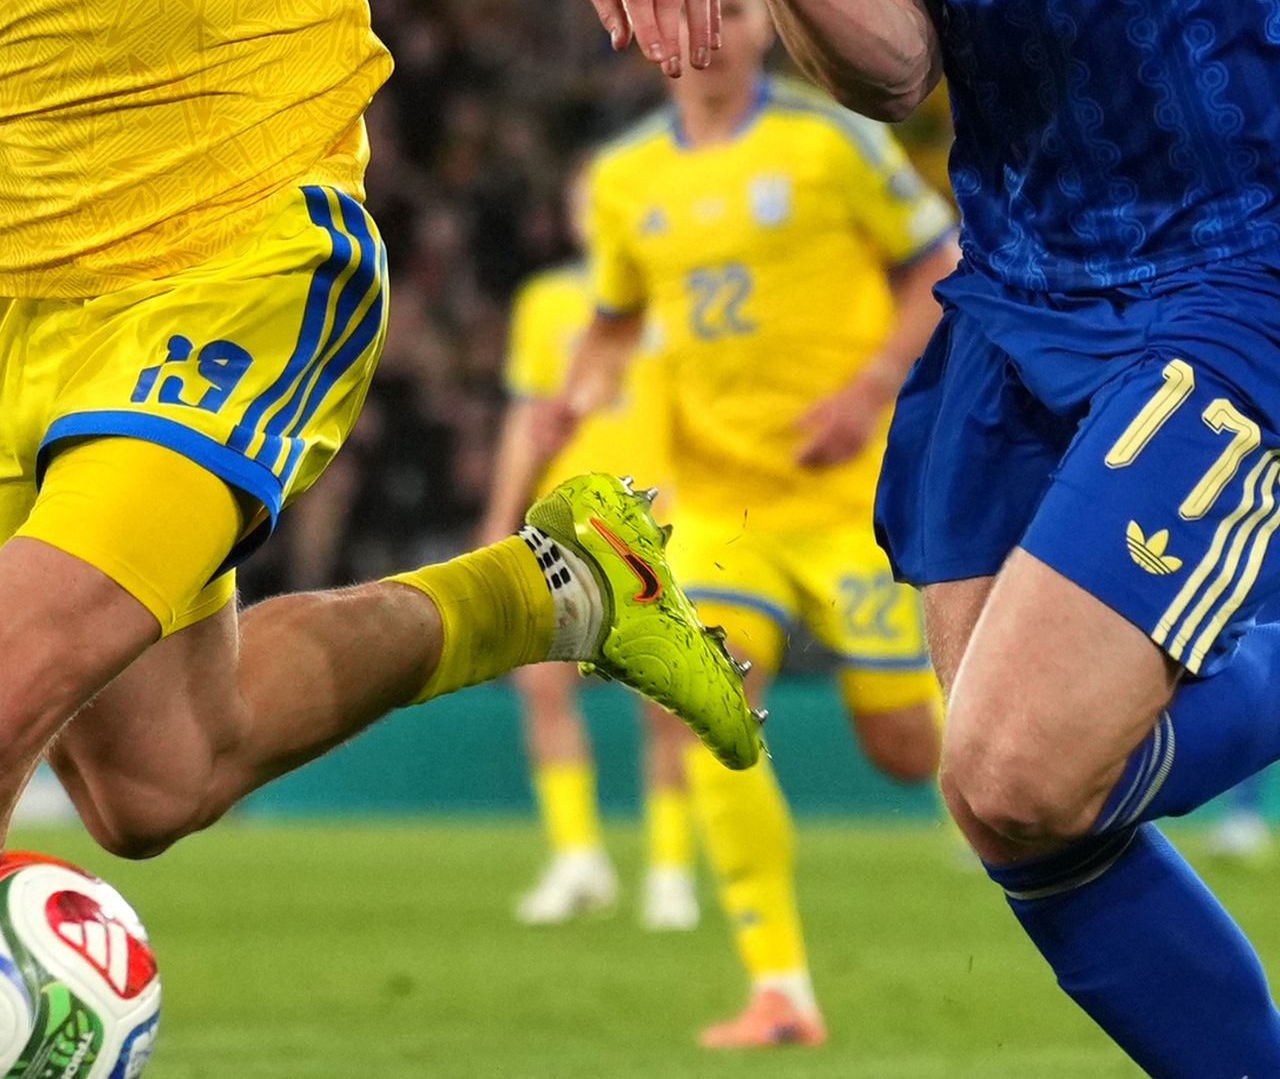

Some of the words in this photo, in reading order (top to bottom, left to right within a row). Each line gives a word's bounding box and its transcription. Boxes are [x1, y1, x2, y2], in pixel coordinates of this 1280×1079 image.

[686, 261, 758, 340] 22
[1104, 358, 1262, 521] 17
[840, 572, 901, 638] 22
